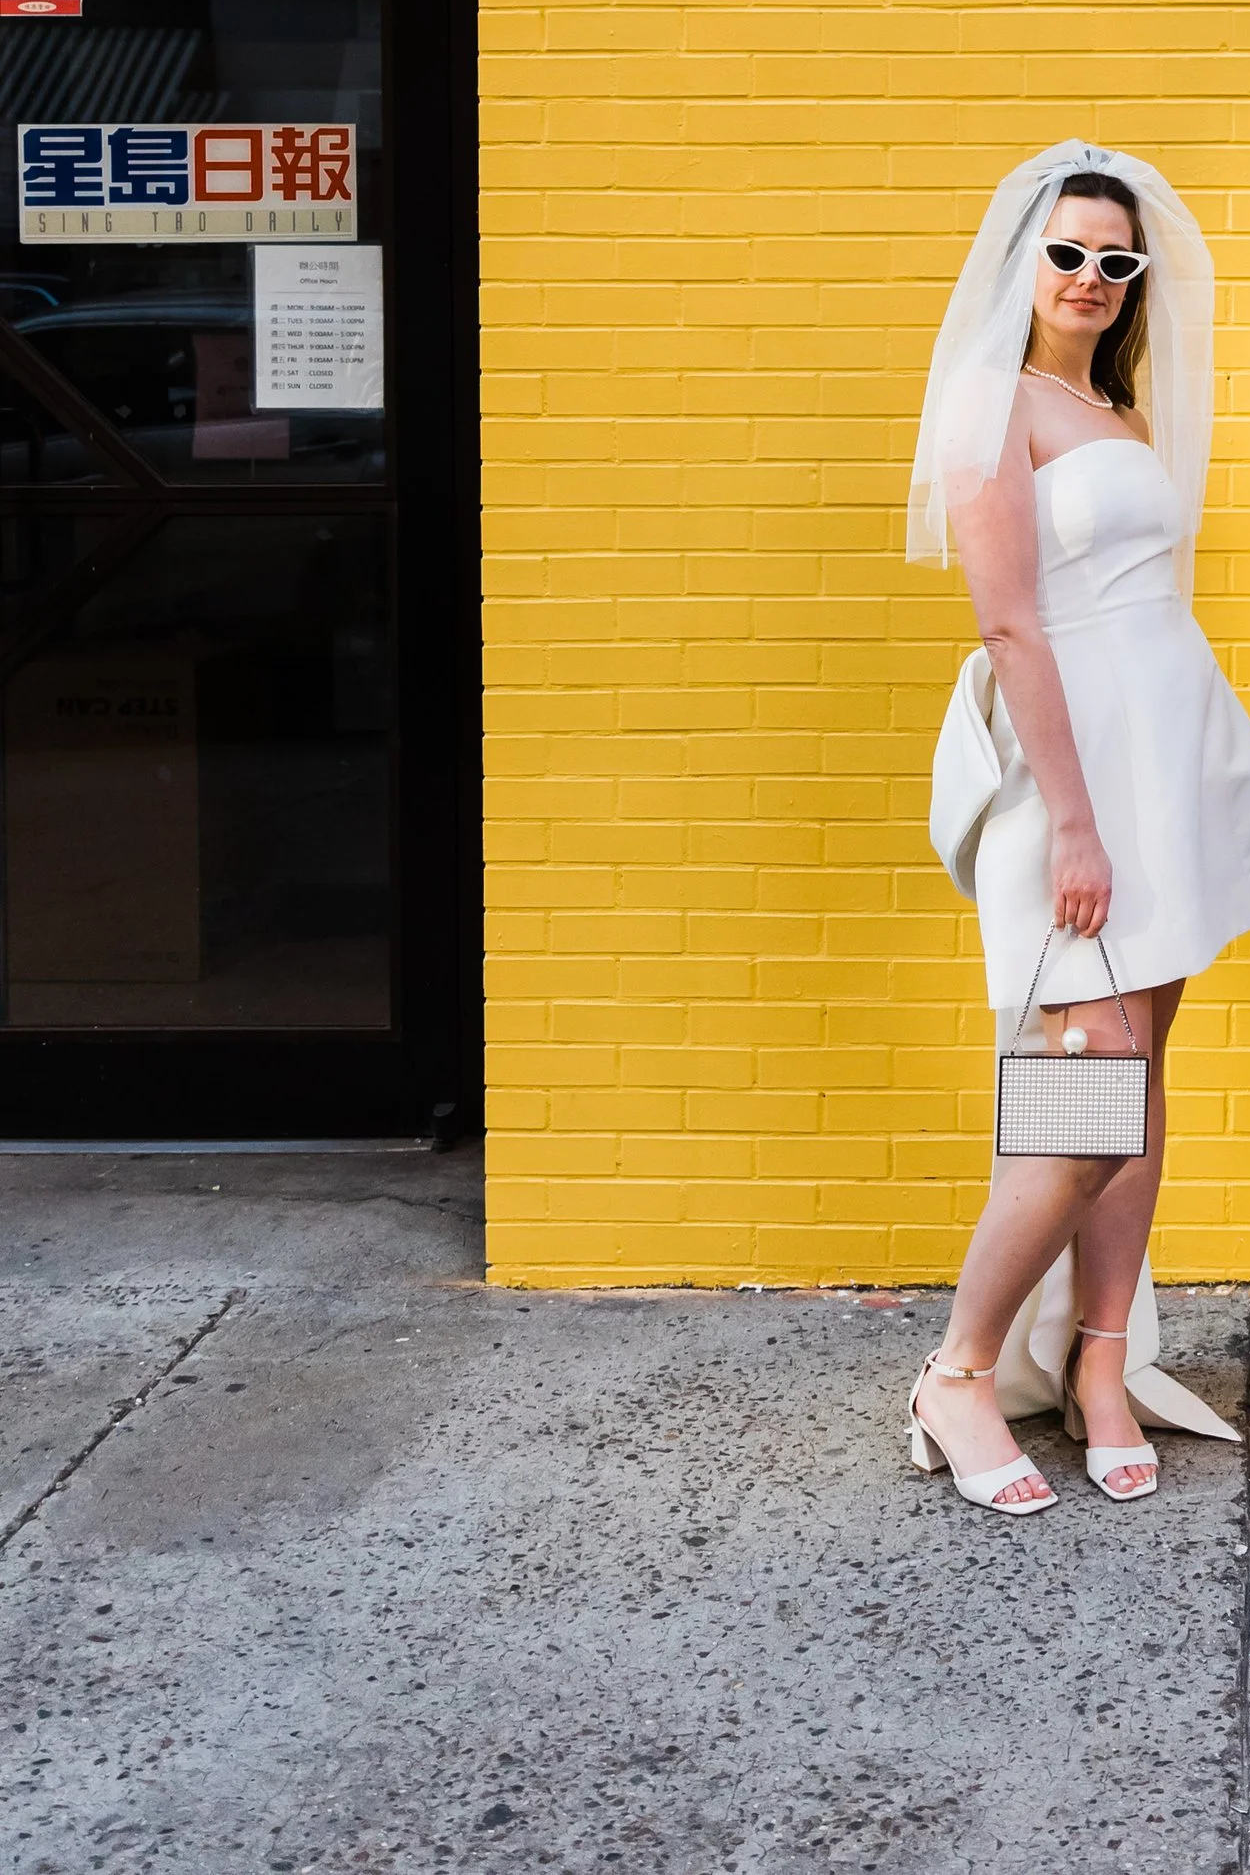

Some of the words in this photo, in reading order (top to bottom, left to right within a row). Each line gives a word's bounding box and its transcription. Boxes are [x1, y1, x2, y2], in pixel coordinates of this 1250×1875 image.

[23, 127, 352, 206] 星島日報
[39, 212, 112, 233] SING
[152, 211, 206, 233] TAO
[246, 211, 343, 232] DAILY
[56, 697, 111, 716] CAN
[118, 697, 180, 716] STEP
